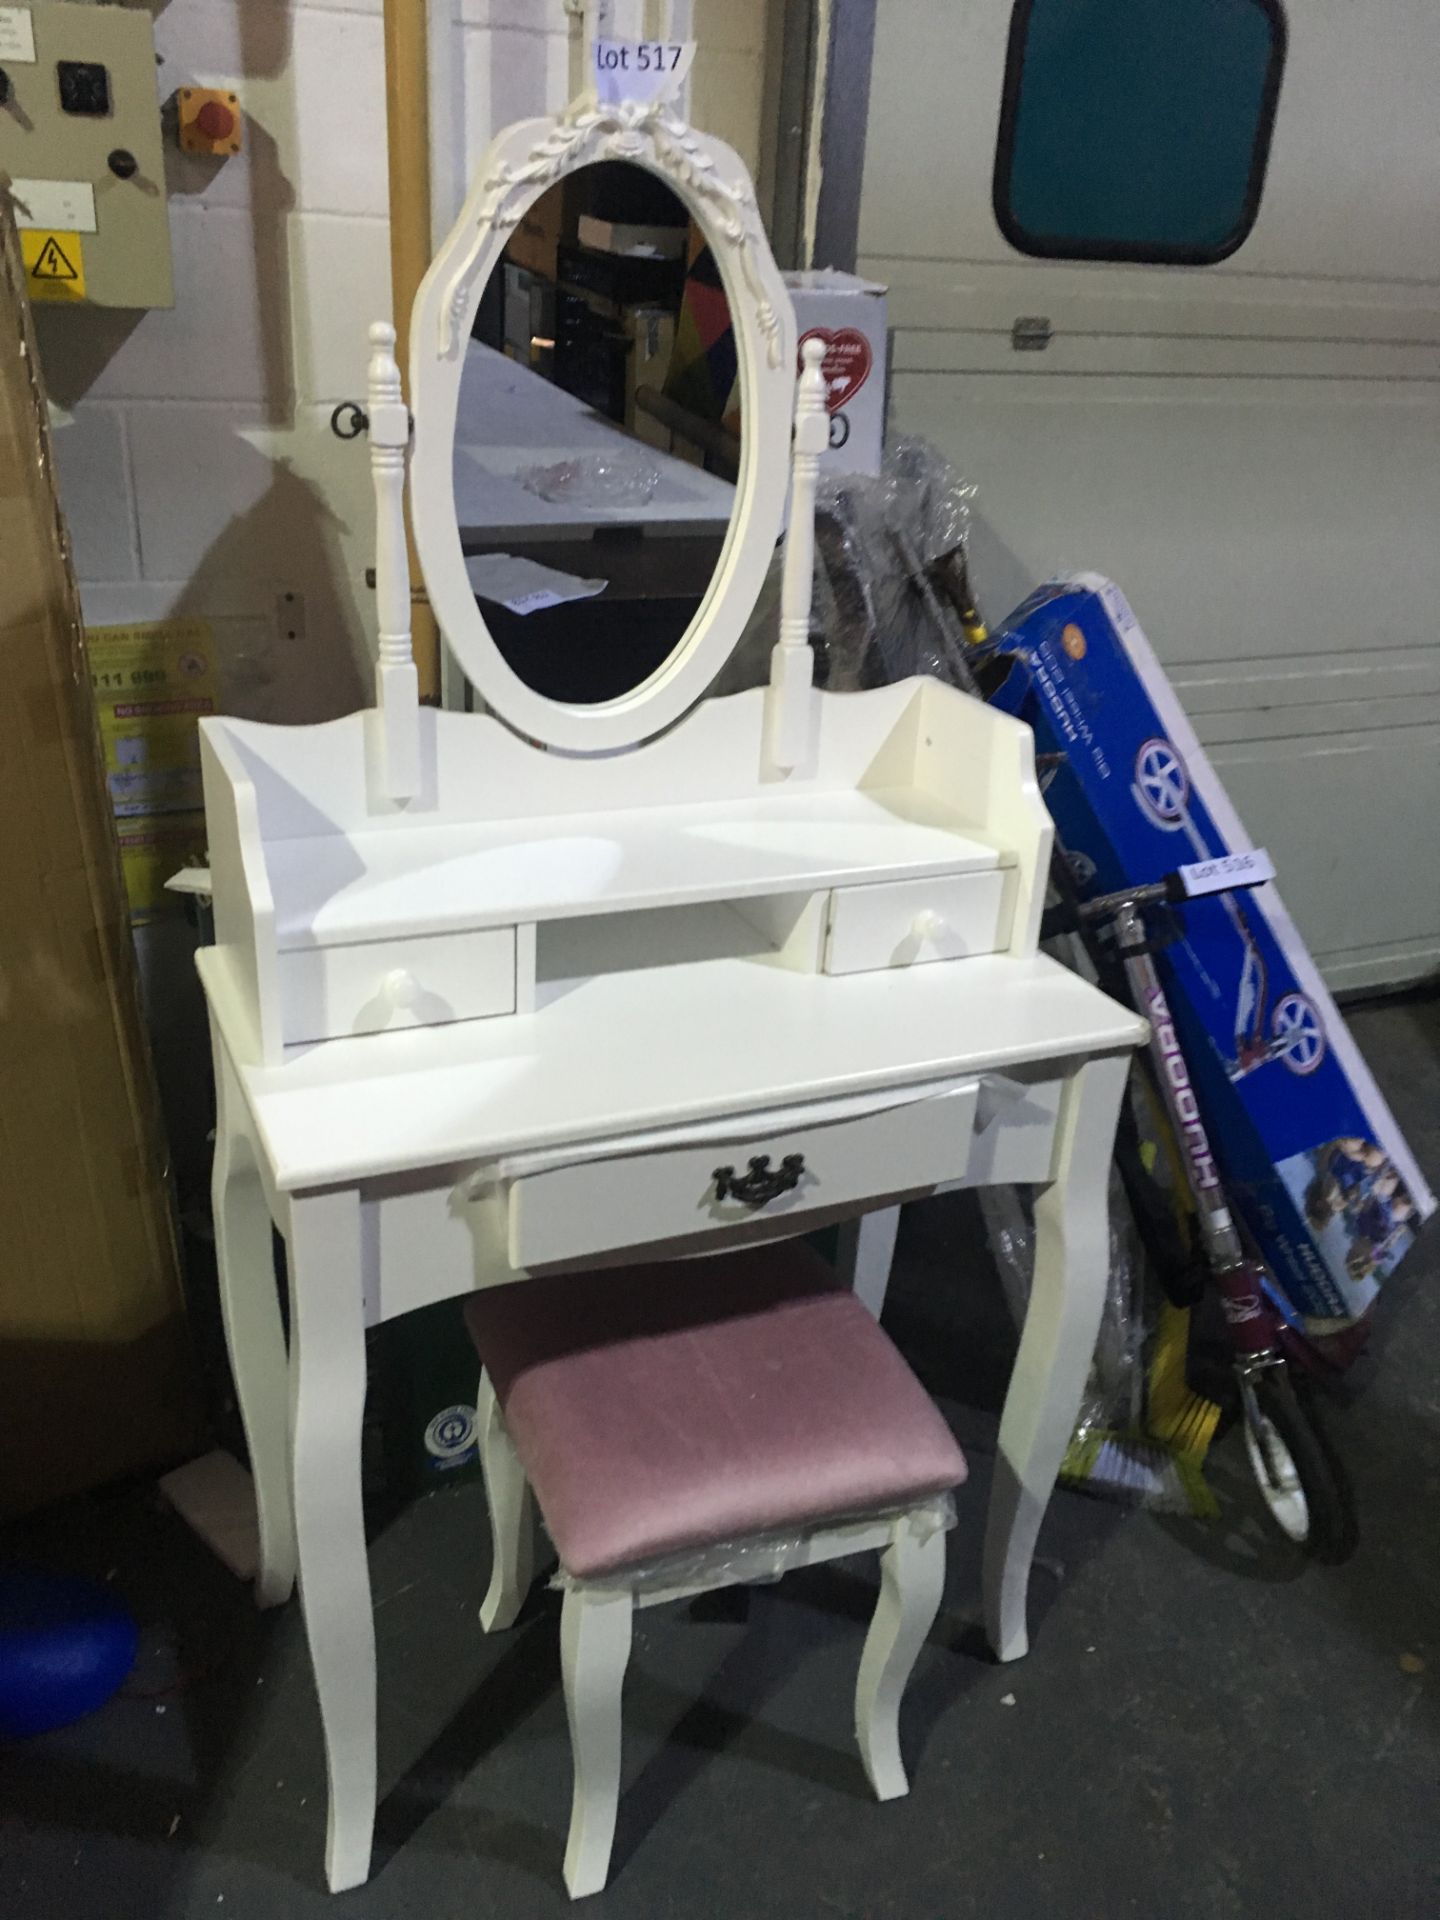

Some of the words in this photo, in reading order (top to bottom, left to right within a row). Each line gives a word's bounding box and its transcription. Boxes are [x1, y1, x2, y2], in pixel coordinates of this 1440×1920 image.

[637, 44, 682, 71] 517
[1030, 650, 1078, 742] HUDORA
[1190, 863, 1220, 880] Lot
[1150, 990, 1219, 1188] HUDORA
